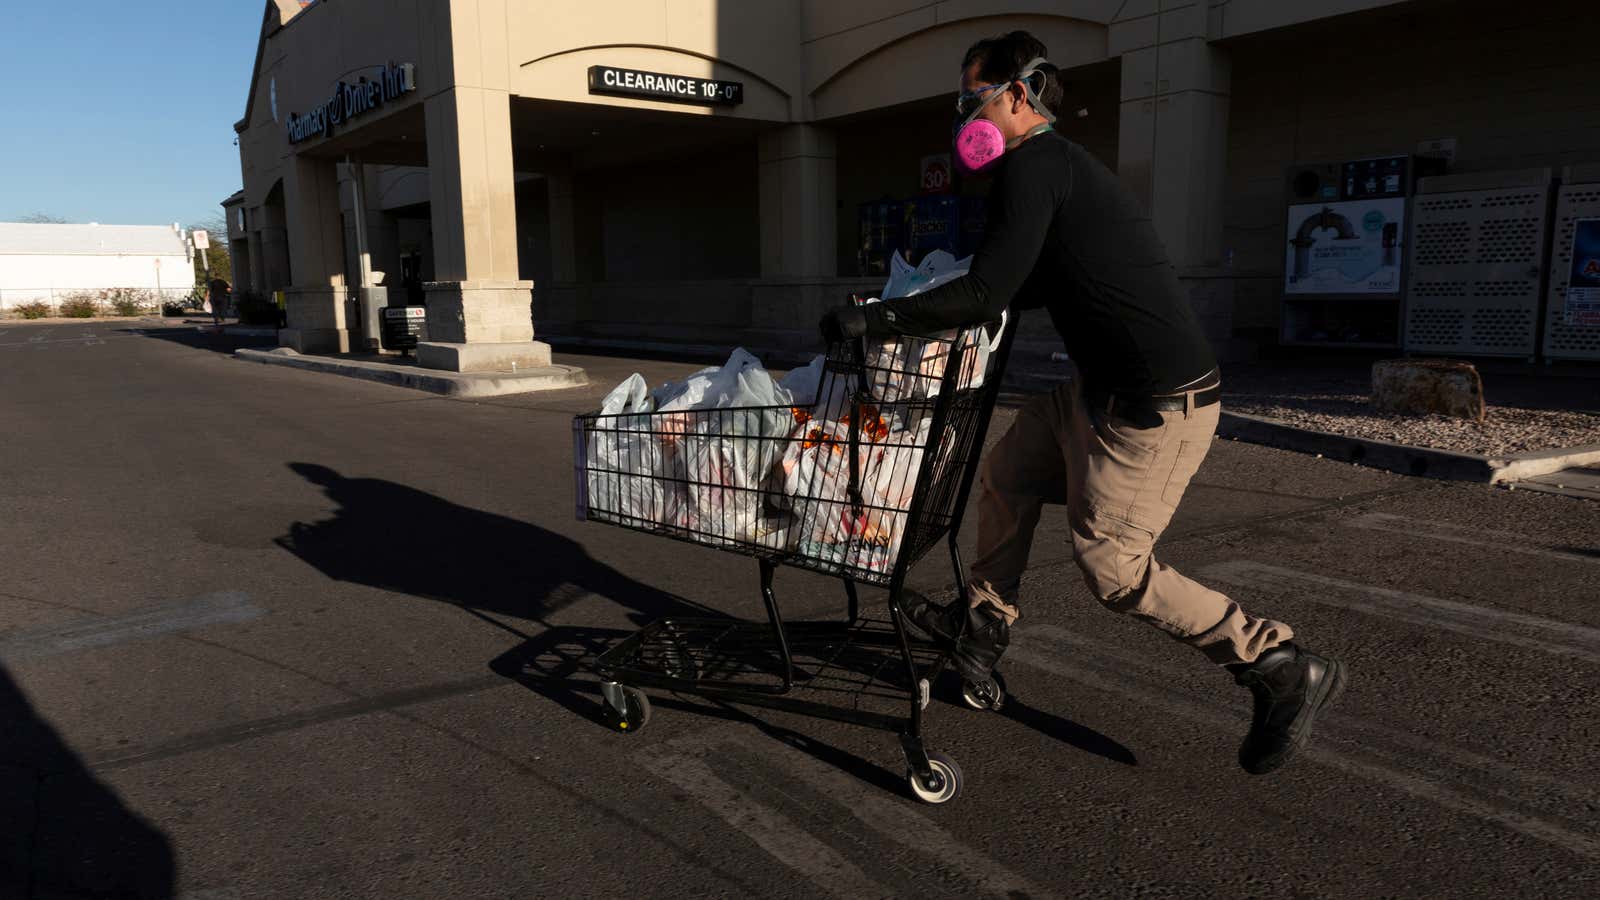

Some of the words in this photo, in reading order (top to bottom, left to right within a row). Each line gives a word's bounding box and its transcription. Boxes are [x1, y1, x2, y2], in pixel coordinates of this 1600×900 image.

[286, 104, 331, 143] Pharmacy
[343, 61, 416, 119] Drive-Thru
[603, 69, 697, 95] CLEARANCE
